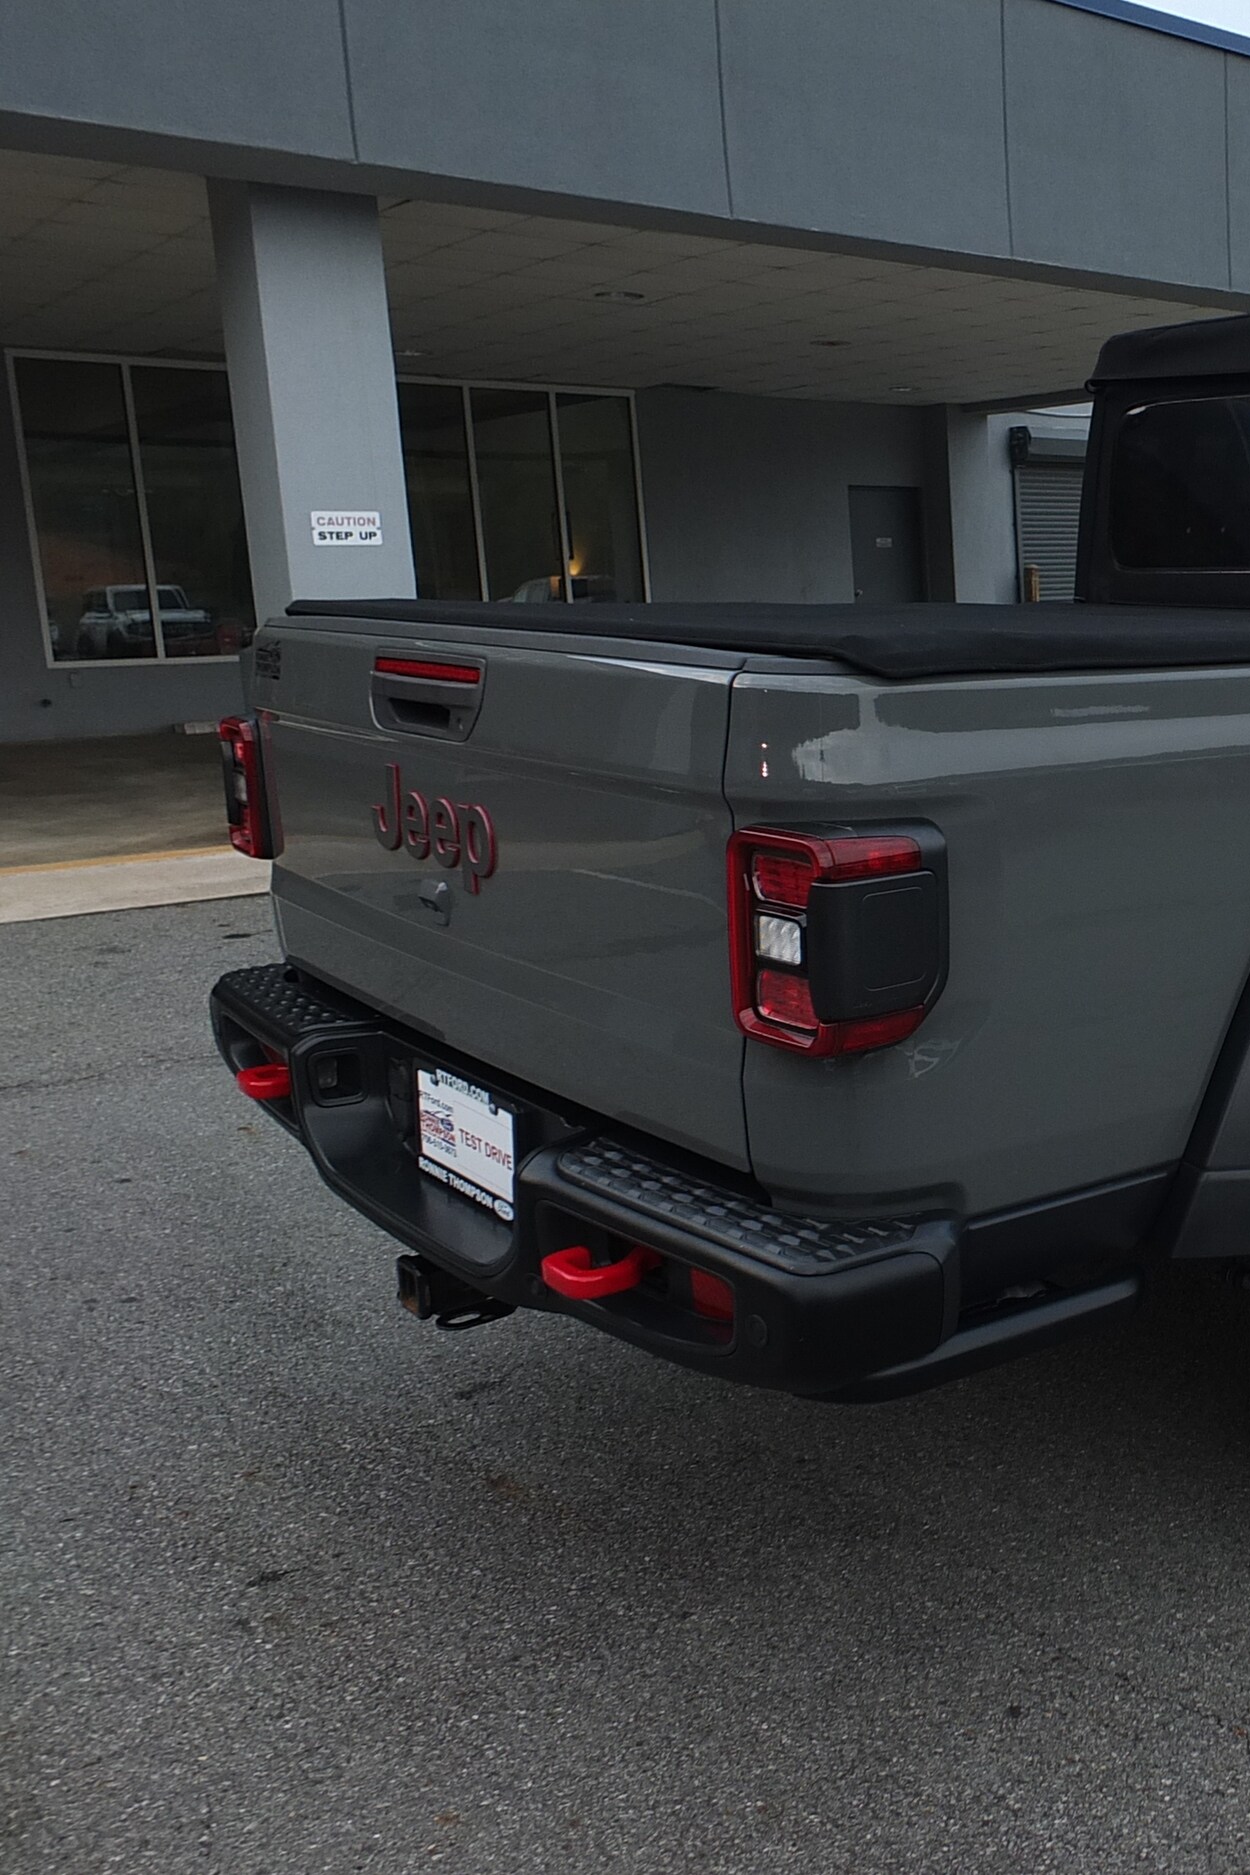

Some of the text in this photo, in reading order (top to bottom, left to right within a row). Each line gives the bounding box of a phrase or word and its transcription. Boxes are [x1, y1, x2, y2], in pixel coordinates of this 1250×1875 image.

[316, 516, 376, 527] CAUTION
[318, 531, 378, 541] STEP UP
[371, 760, 499, 896] Jeep
[458, 1128, 483, 1153] TEST
[484, 1141, 513, 1171] DRIVE
